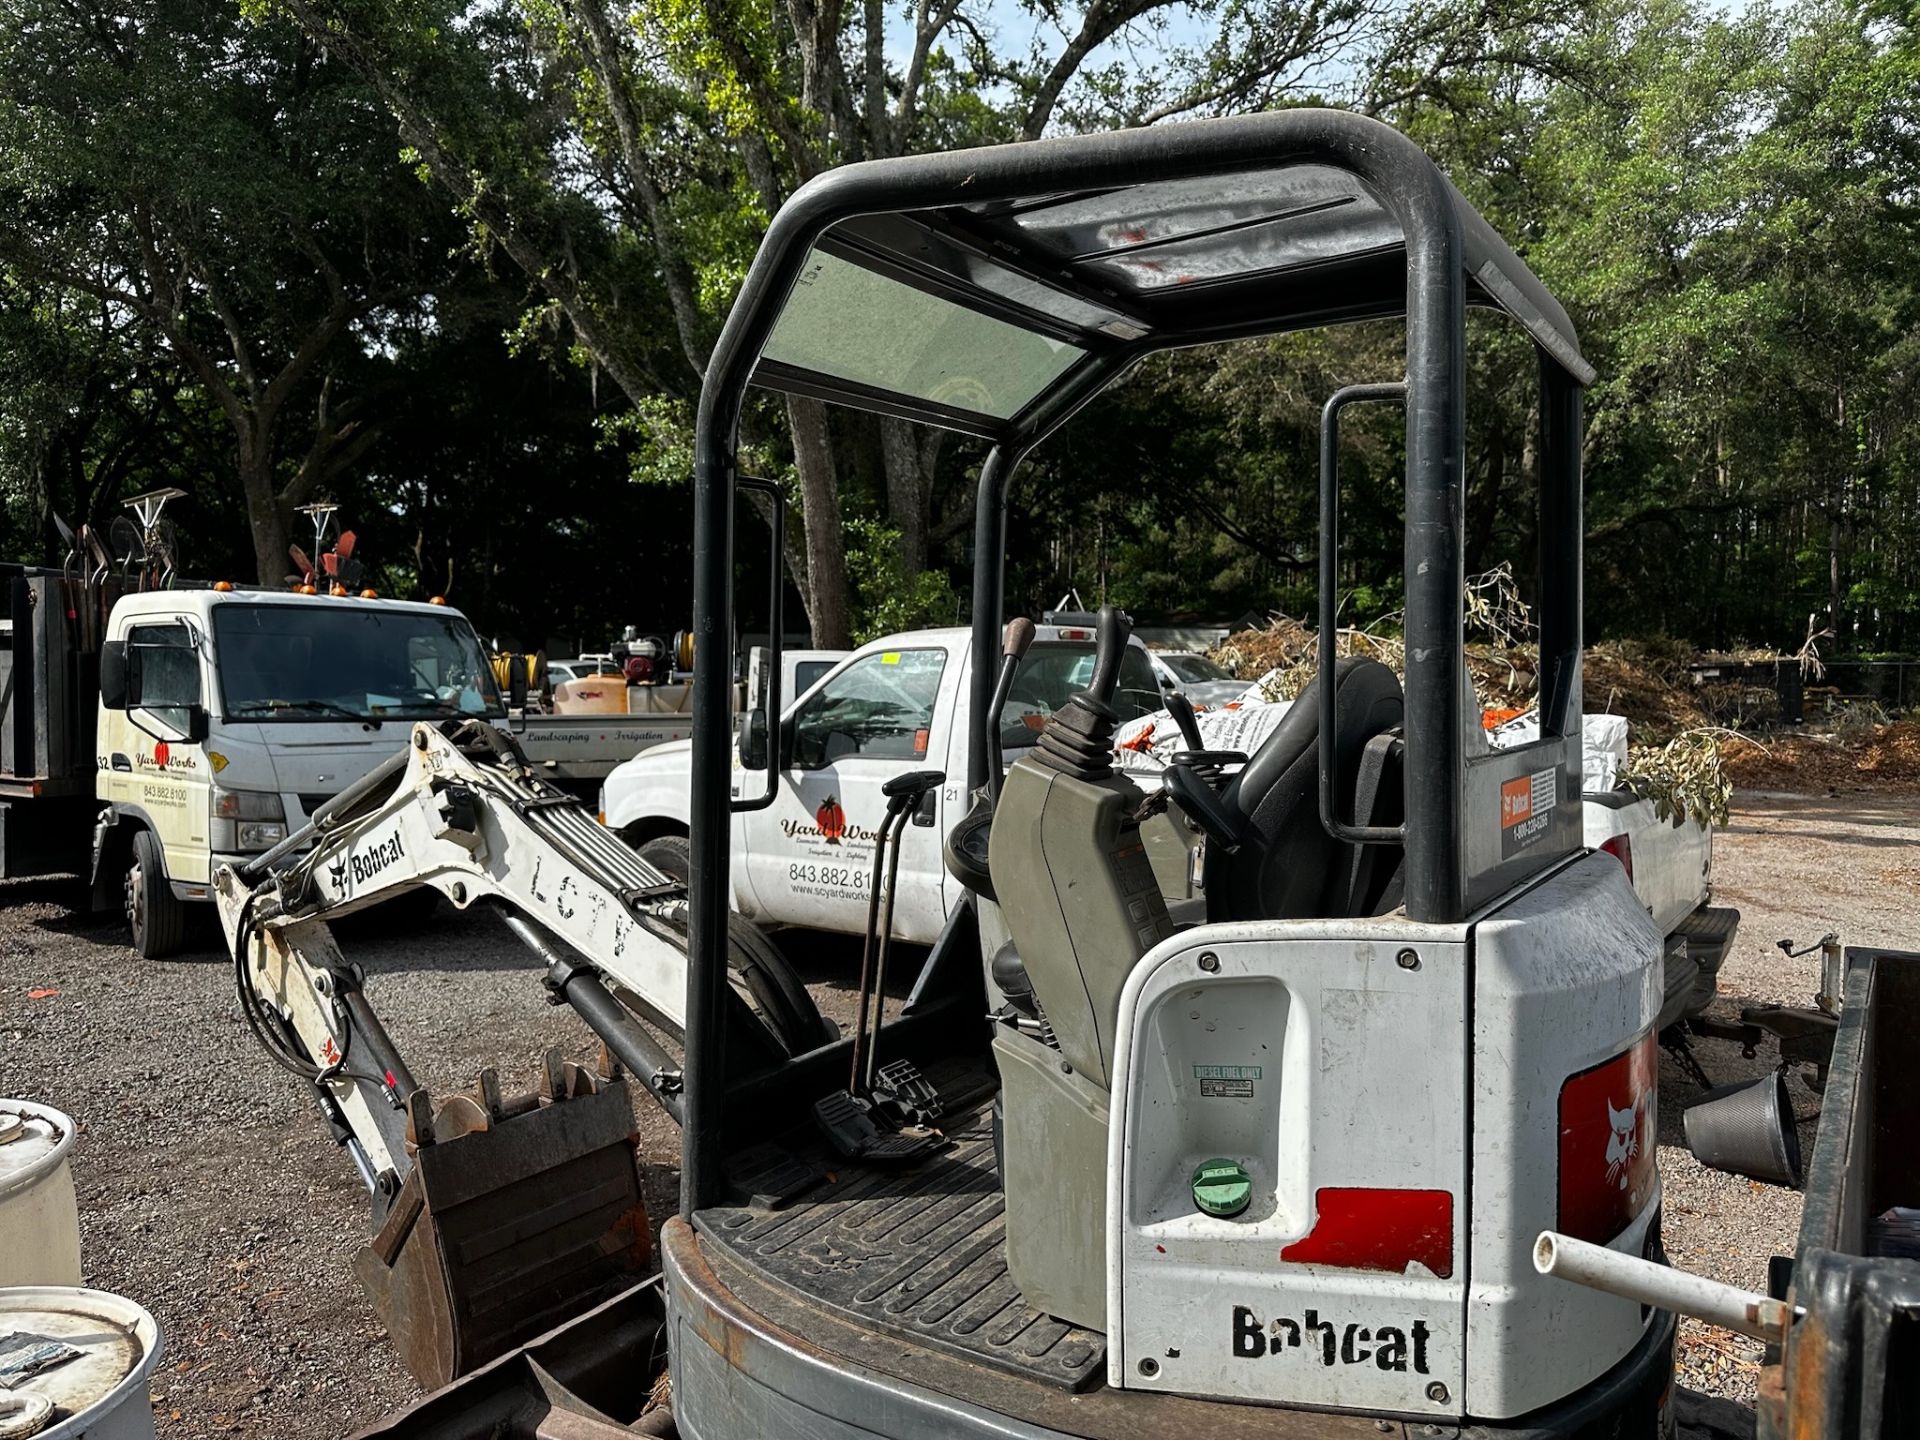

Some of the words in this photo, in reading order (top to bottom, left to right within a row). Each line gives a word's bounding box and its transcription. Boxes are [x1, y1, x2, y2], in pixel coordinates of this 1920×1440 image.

[526, 731, 590, 744] Landscaping
[614, 731, 663, 742] Irrigation
[144, 785, 187, 801] 843.882.8100
[946, 789, 958, 801] 21
[780, 818, 828, 837] Yard
[351, 830, 405, 884] Bobcat
[1195, 1066, 1220, 1078] DIESEL
[1222, 1066, 1240, 1078] FUEL
[1241, 1066, 1261, 1079] ONLY
